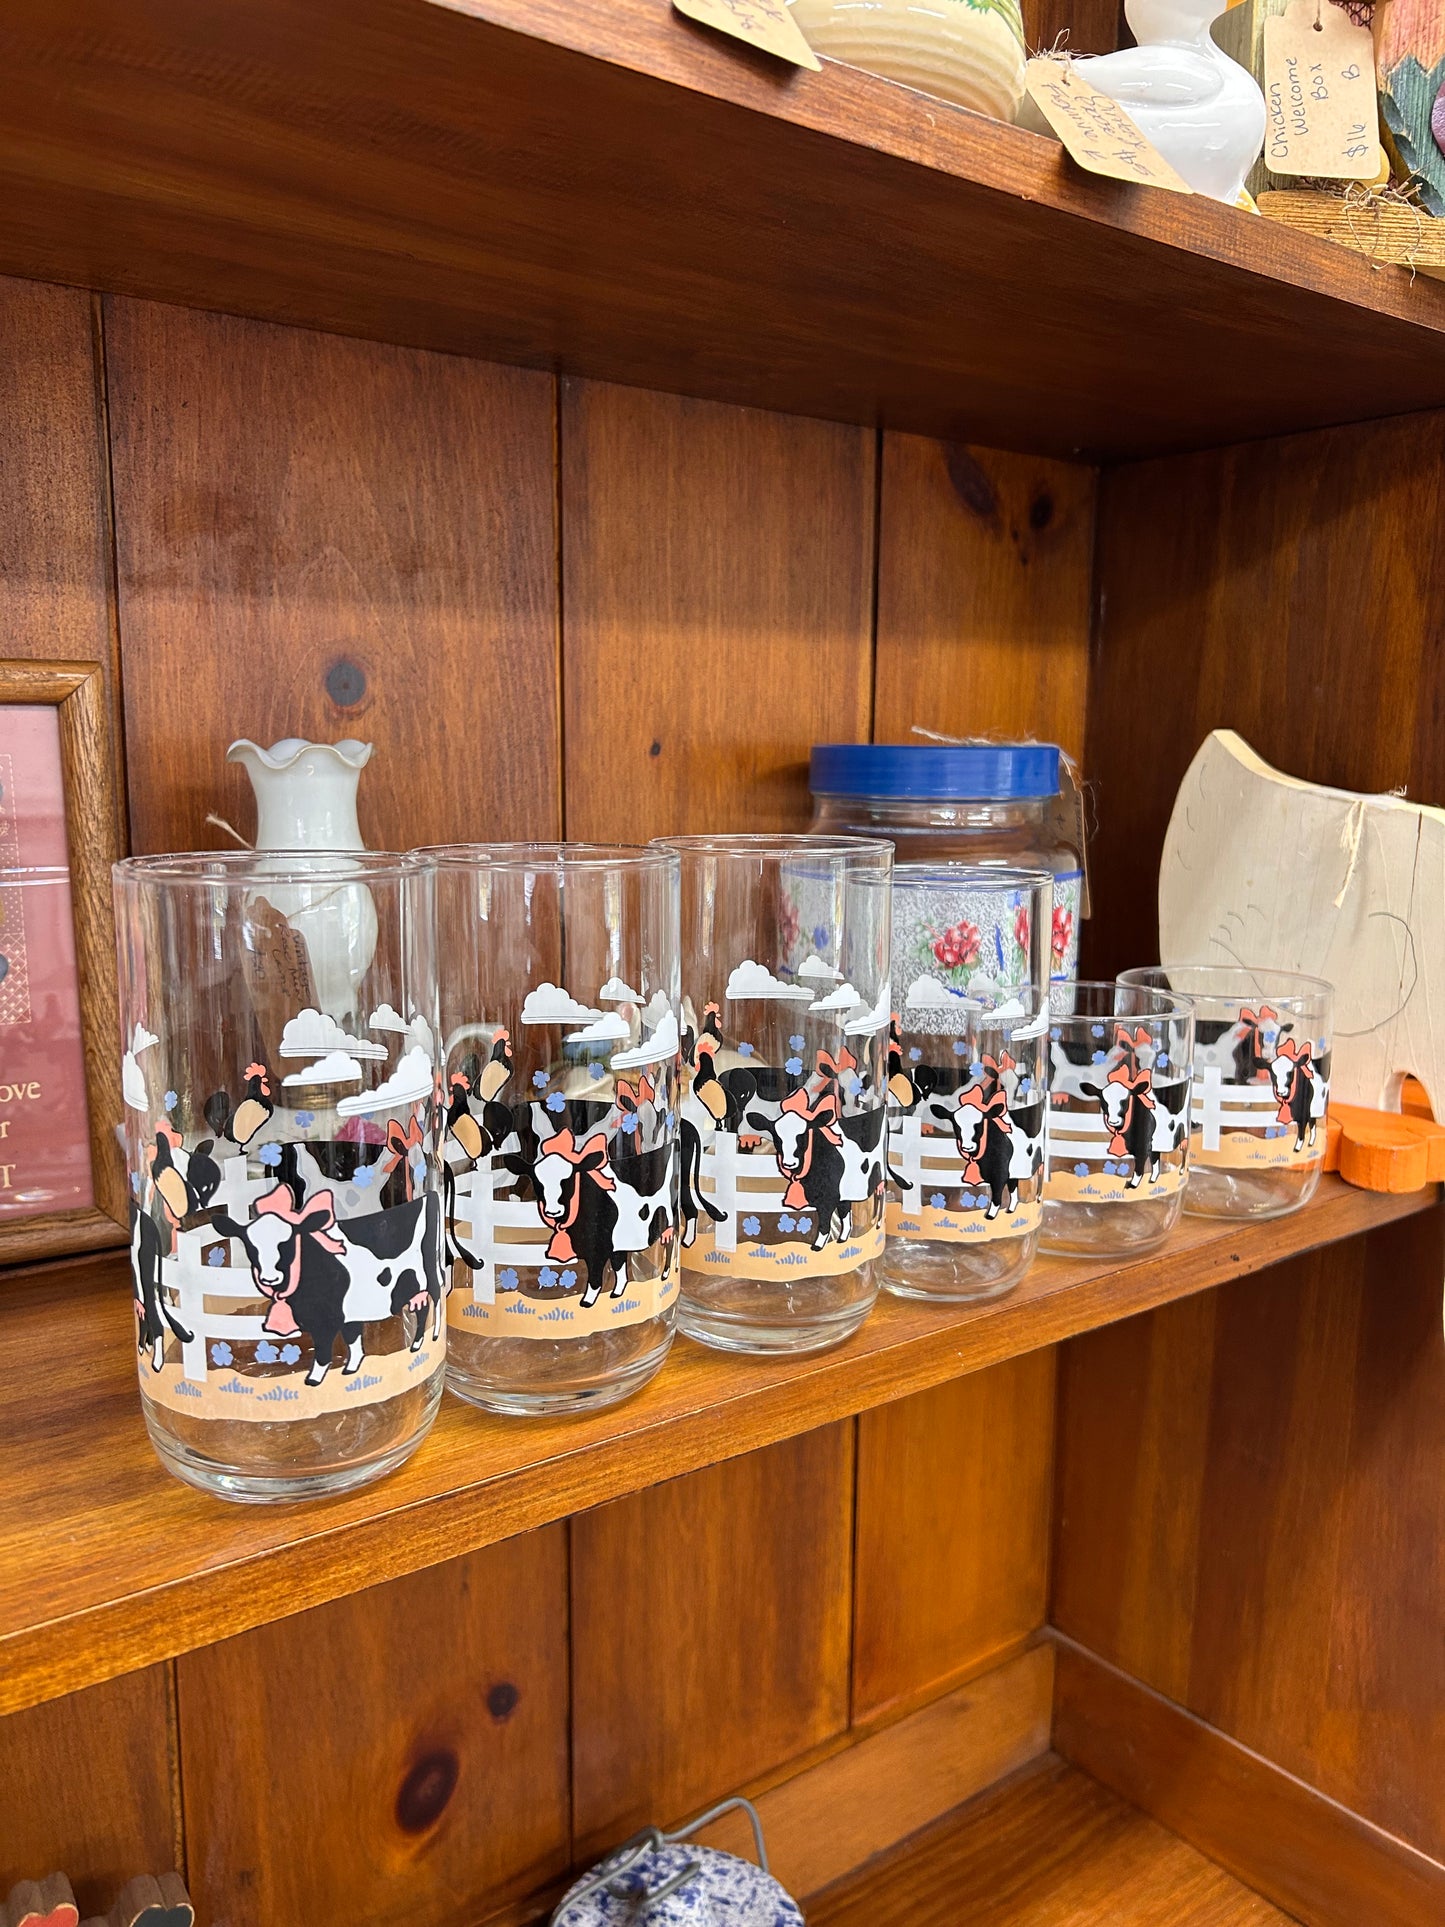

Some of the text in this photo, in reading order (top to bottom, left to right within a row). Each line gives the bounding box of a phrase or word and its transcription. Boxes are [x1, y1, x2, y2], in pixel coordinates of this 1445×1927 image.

[1270, 83, 1289, 158] Chicken
[1286, 57, 1309, 136] Welcome
[1309, 63, 1329, 101] Box
[1341, 63, 1369, 158] $16 B
